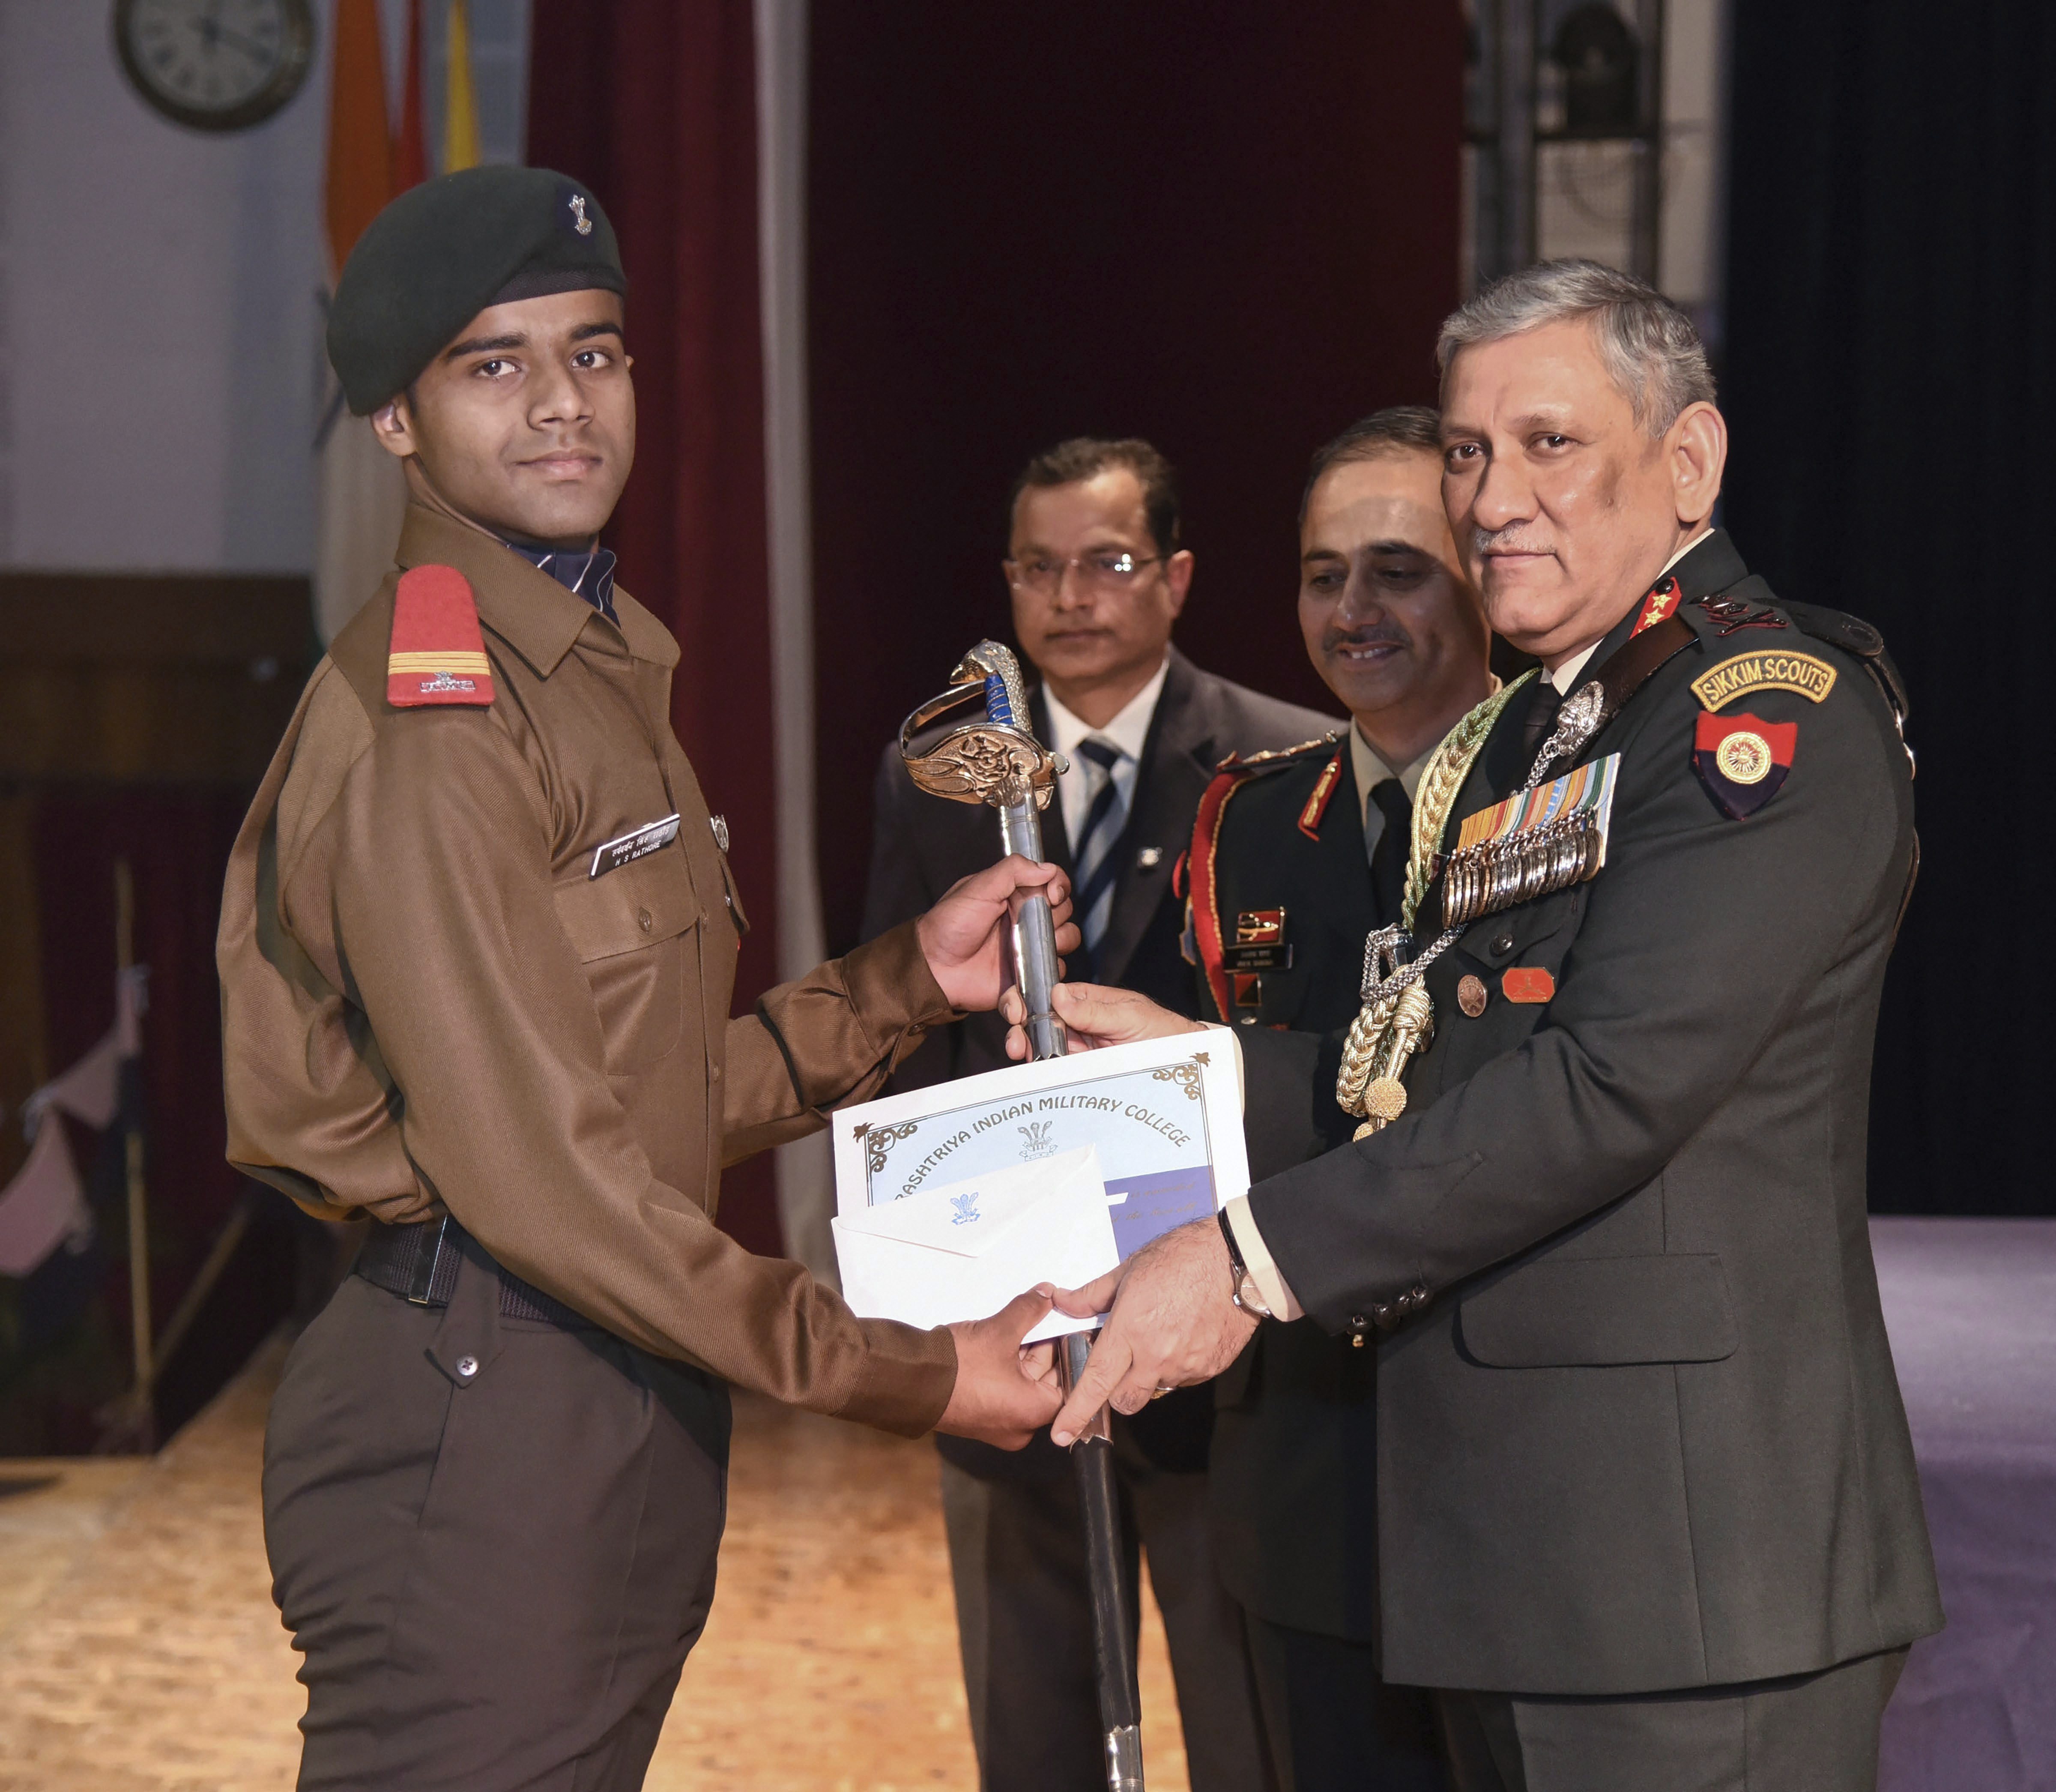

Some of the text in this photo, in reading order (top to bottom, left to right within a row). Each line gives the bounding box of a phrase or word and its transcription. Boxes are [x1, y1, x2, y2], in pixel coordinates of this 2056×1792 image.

[1703, 658, 1828, 702] SIKKIM SCOUTS
[615, 840, 662, 867] H S RATHORE
[972, 1101, 1033, 1134] INDIAN
[1039, 1095, 1123, 1112] MILITARY
[1124, 1104, 1191, 1147] COLLEGE
